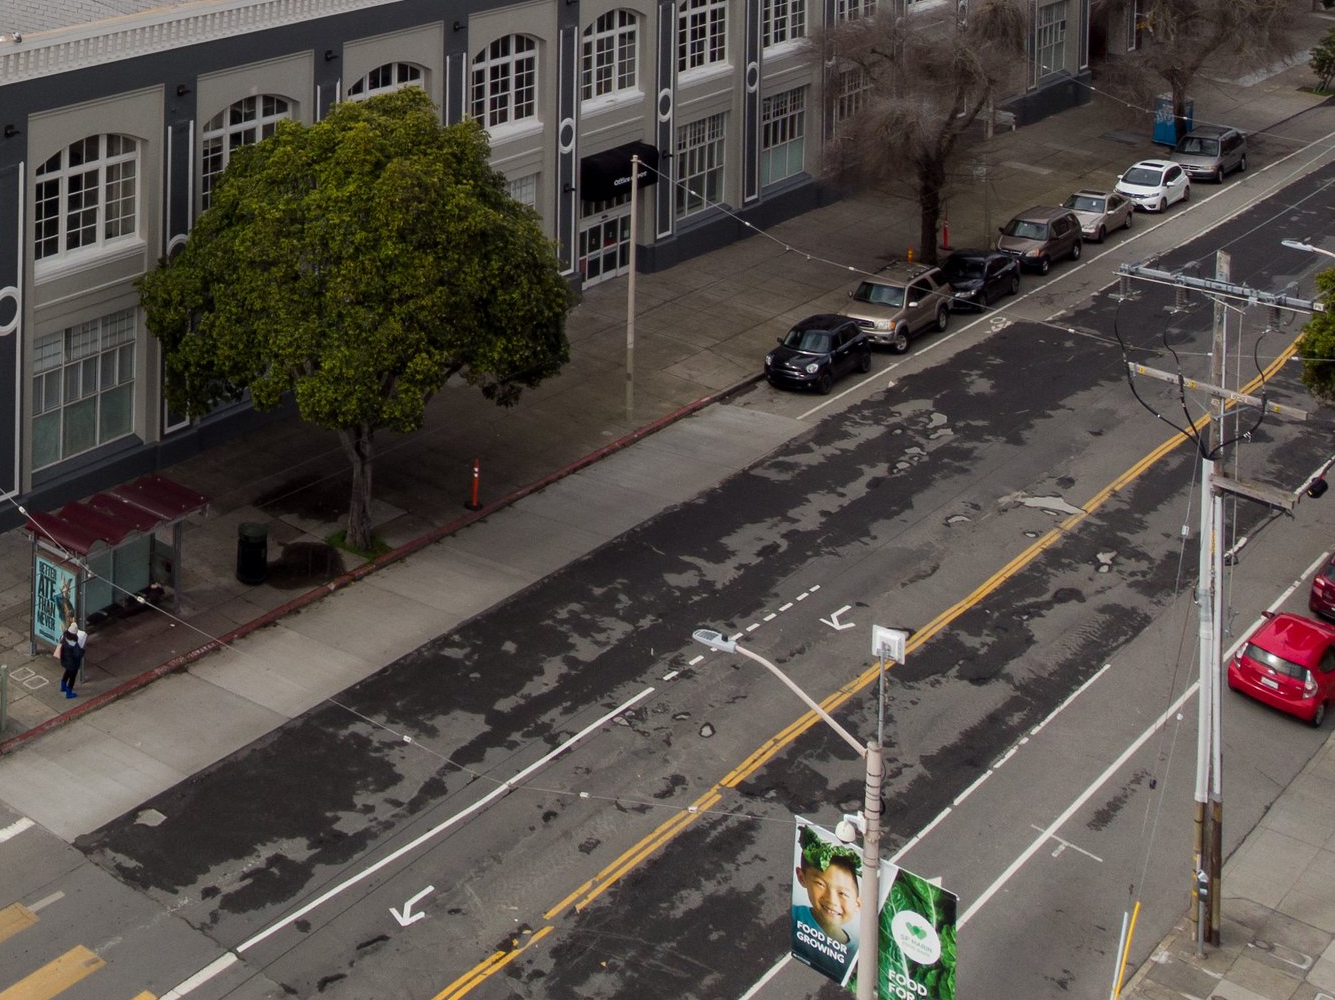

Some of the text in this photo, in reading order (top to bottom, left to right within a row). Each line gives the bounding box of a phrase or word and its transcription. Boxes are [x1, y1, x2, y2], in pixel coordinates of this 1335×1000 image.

[614, 177, 630, 186] Office
[39, 561, 57, 580] BETTER
[38, 574, 56, 601] ATE
[39, 596, 56, 618] THAN
[37, 610, 55, 632] NEVER
[796, 931, 845, 964] GROWING
[797, 920, 848, 954] FOOD FOR
[888, 968, 928, 996] FOOD
